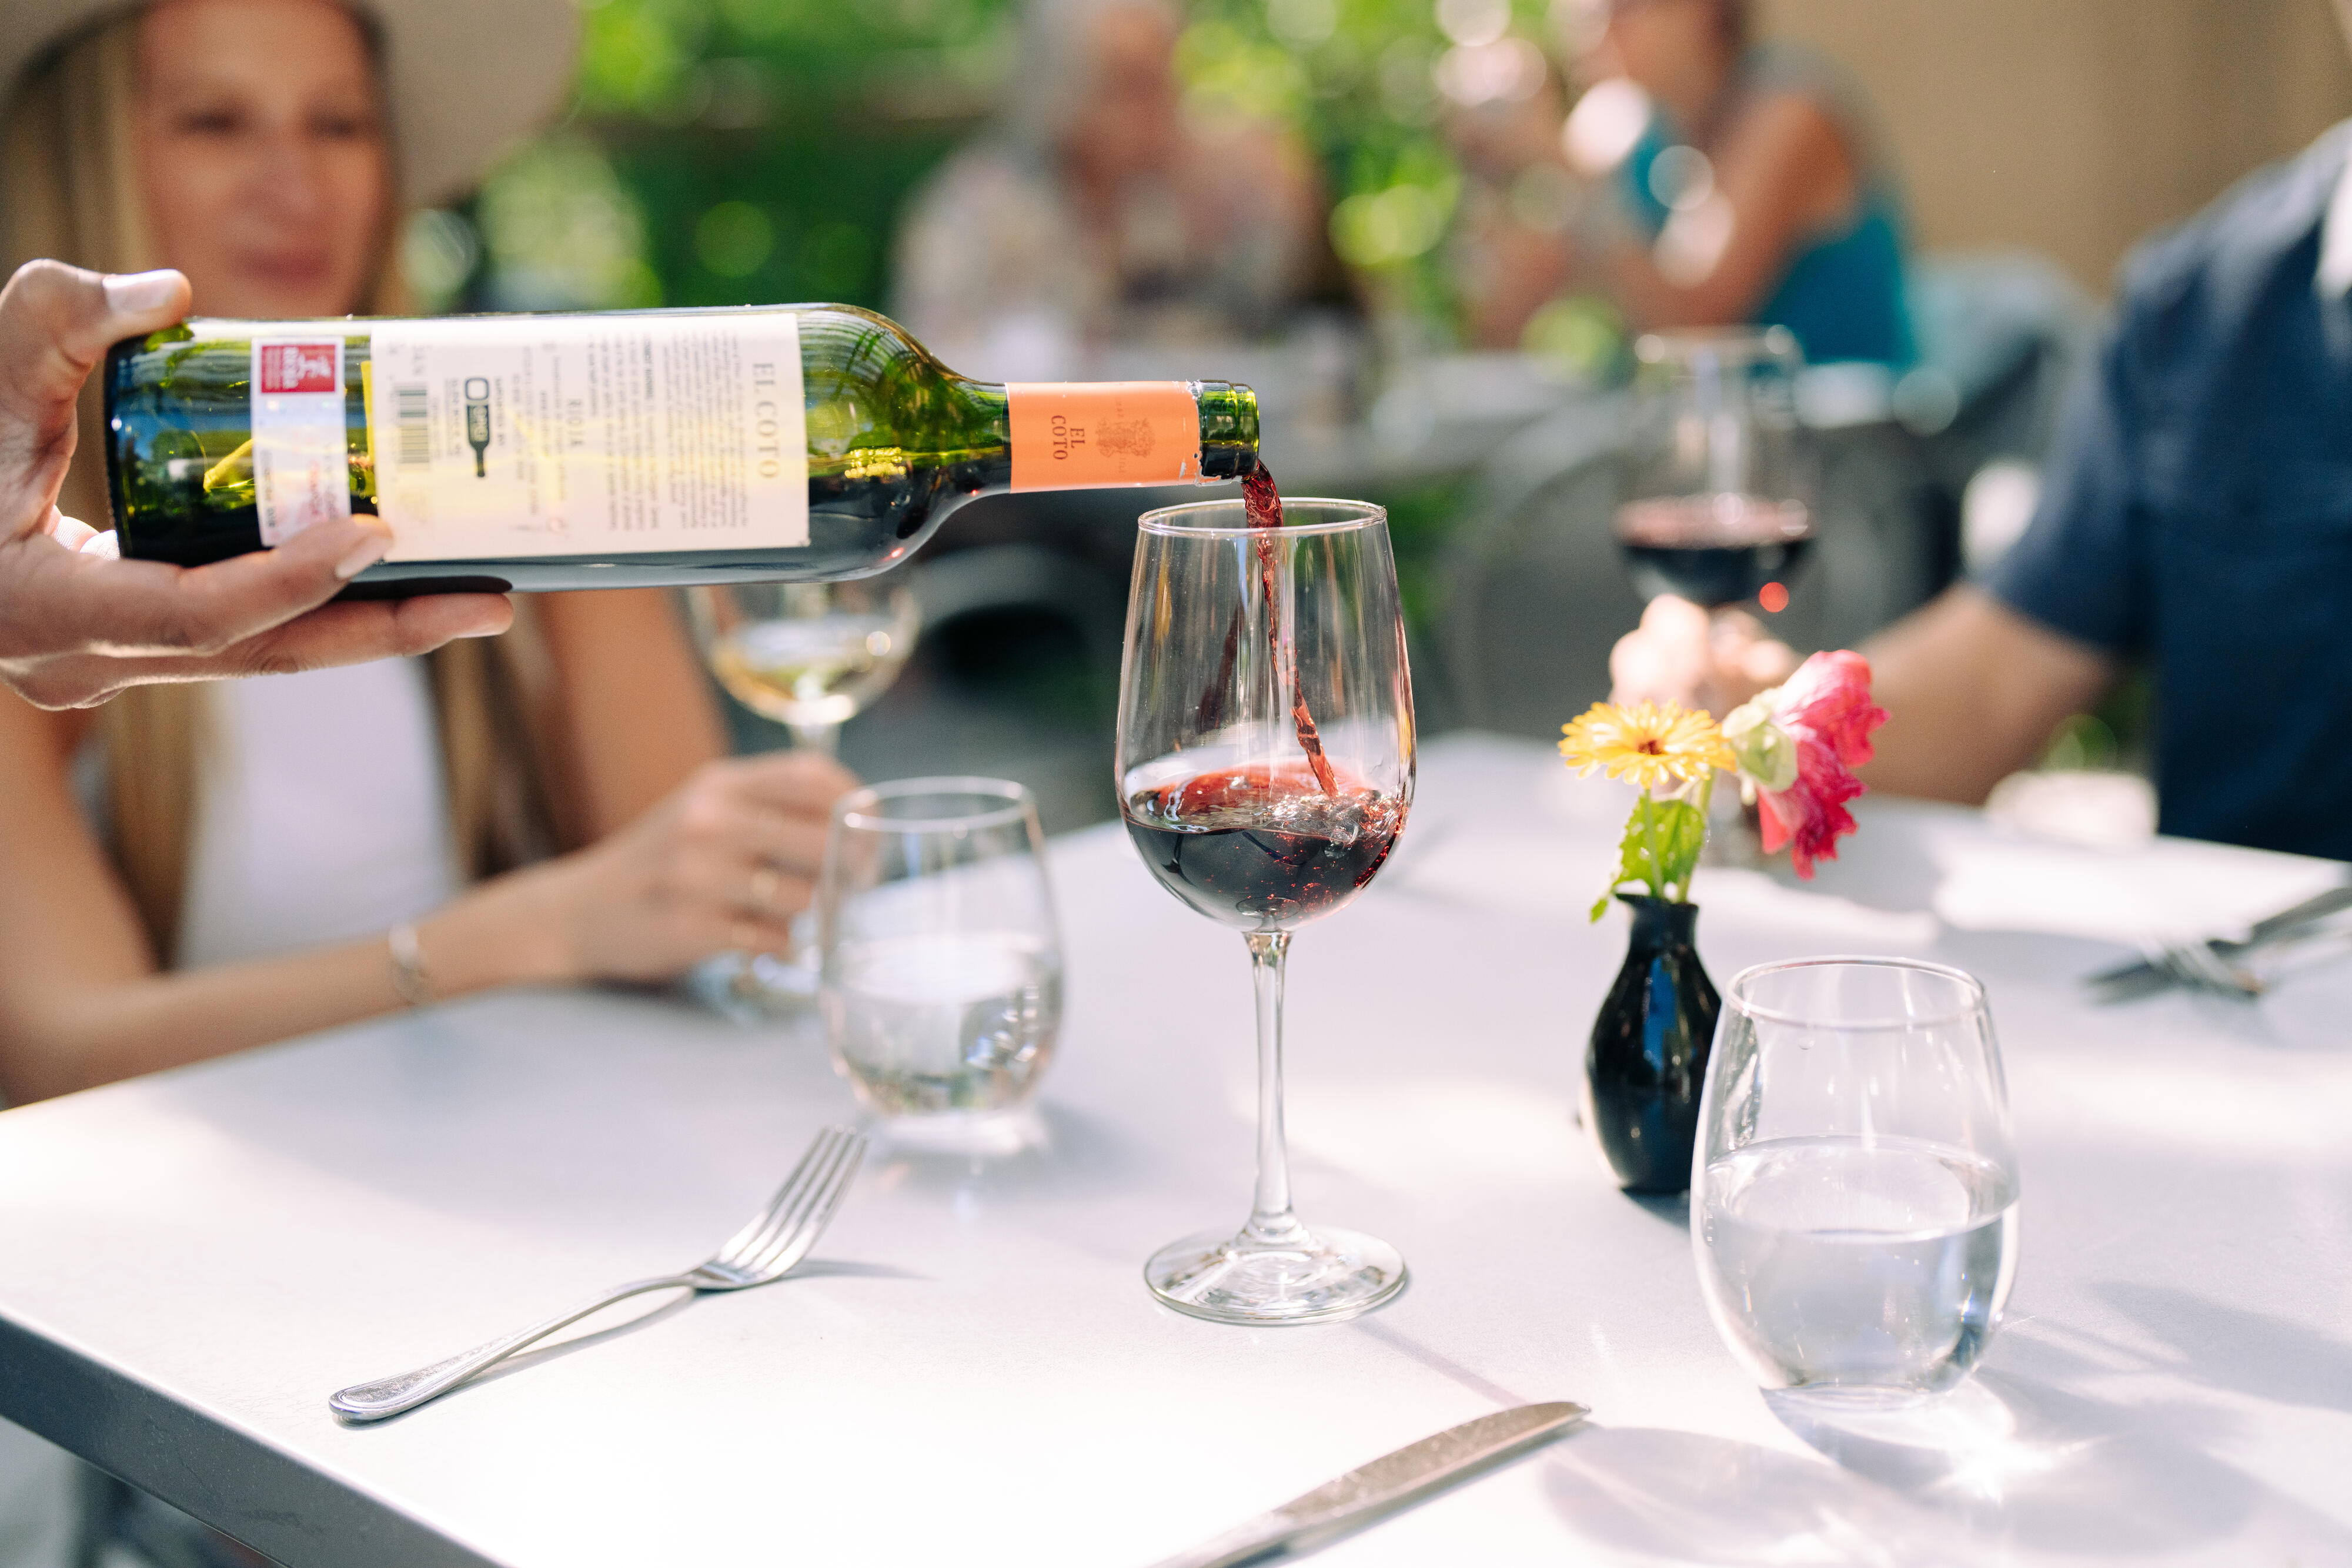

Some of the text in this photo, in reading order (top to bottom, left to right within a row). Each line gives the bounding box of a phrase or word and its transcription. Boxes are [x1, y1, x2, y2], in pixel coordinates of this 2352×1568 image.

[567, 399, 584, 449] RIOJA
[753, 362, 780, 479] EL COTO
[1051, 415, 1068, 460] COTO
[1070, 428, 1085, 449] EL
